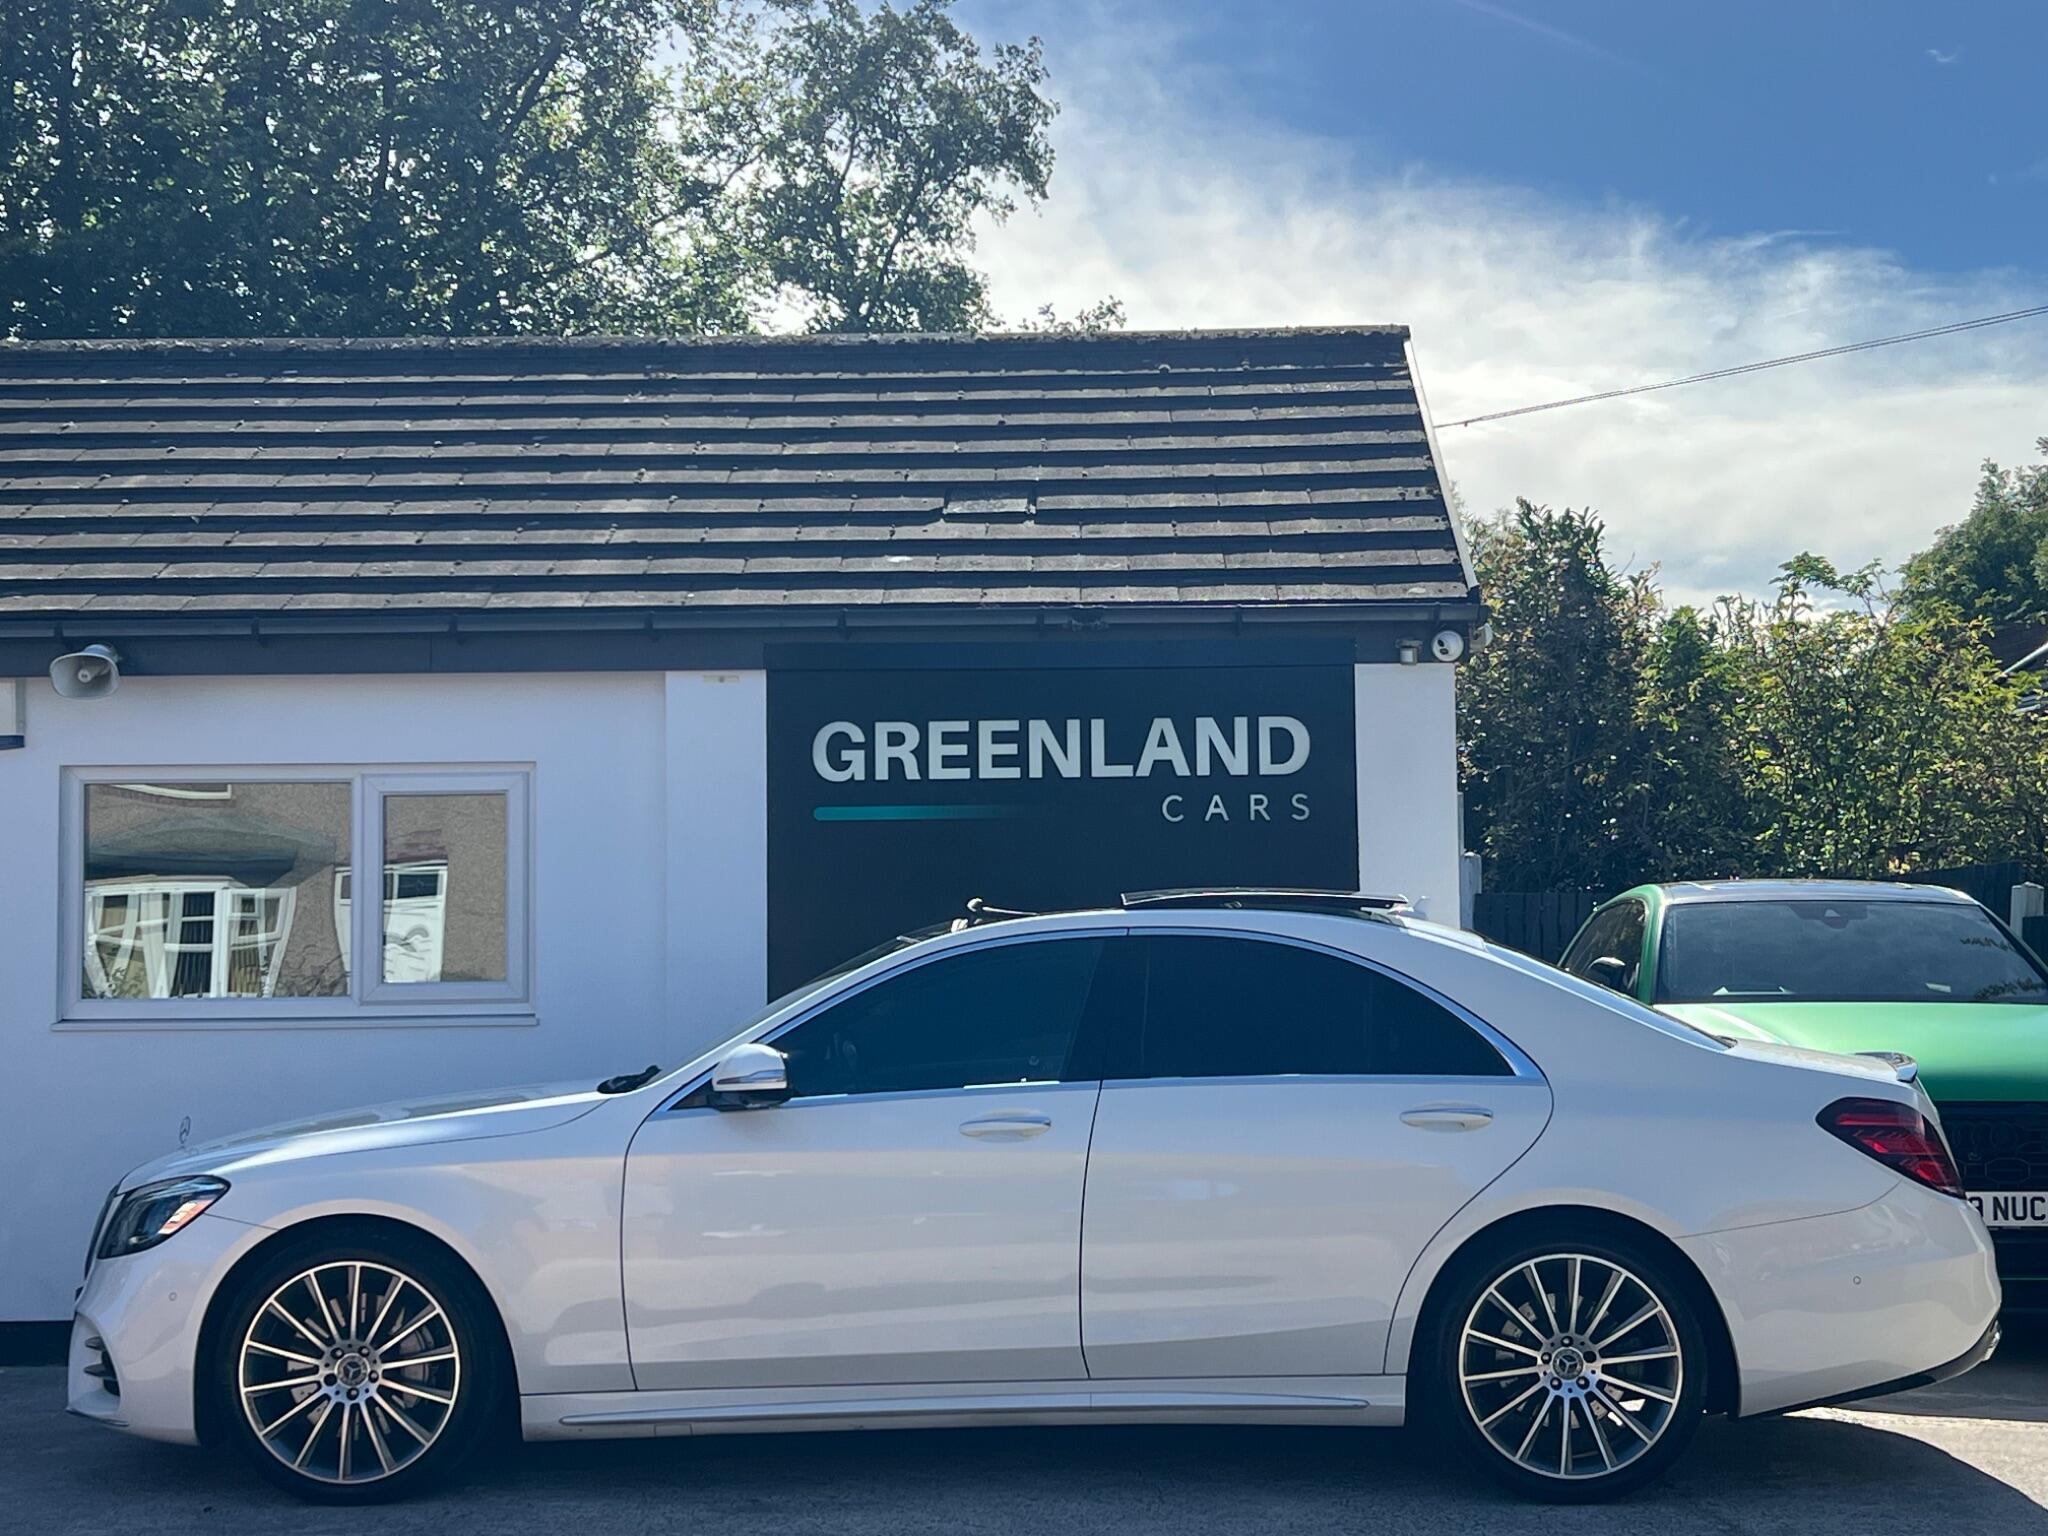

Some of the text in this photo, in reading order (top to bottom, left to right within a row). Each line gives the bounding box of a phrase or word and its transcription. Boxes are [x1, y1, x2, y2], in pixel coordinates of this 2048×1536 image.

[811, 715, 1311, 783] GREENLAND
[1161, 793, 1311, 823] CARS
[1992, 1196, 2046, 1221] NUC
